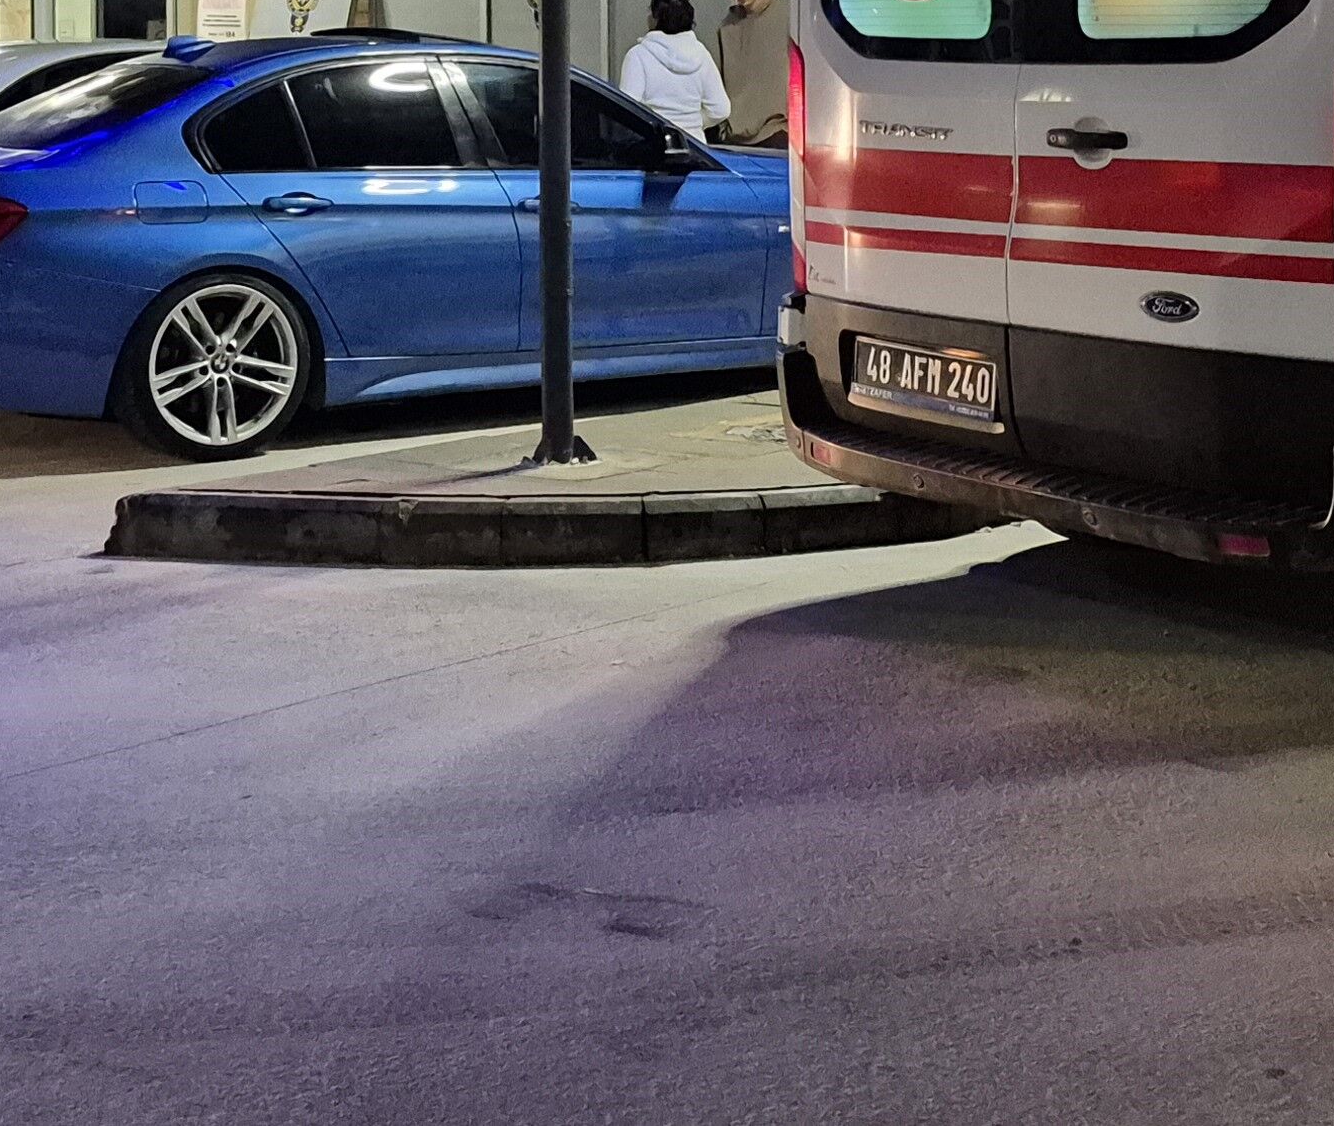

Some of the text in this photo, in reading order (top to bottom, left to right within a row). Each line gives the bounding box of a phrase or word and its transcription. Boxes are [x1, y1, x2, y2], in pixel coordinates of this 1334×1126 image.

[867, 346, 990, 404] 48 AFM 240
